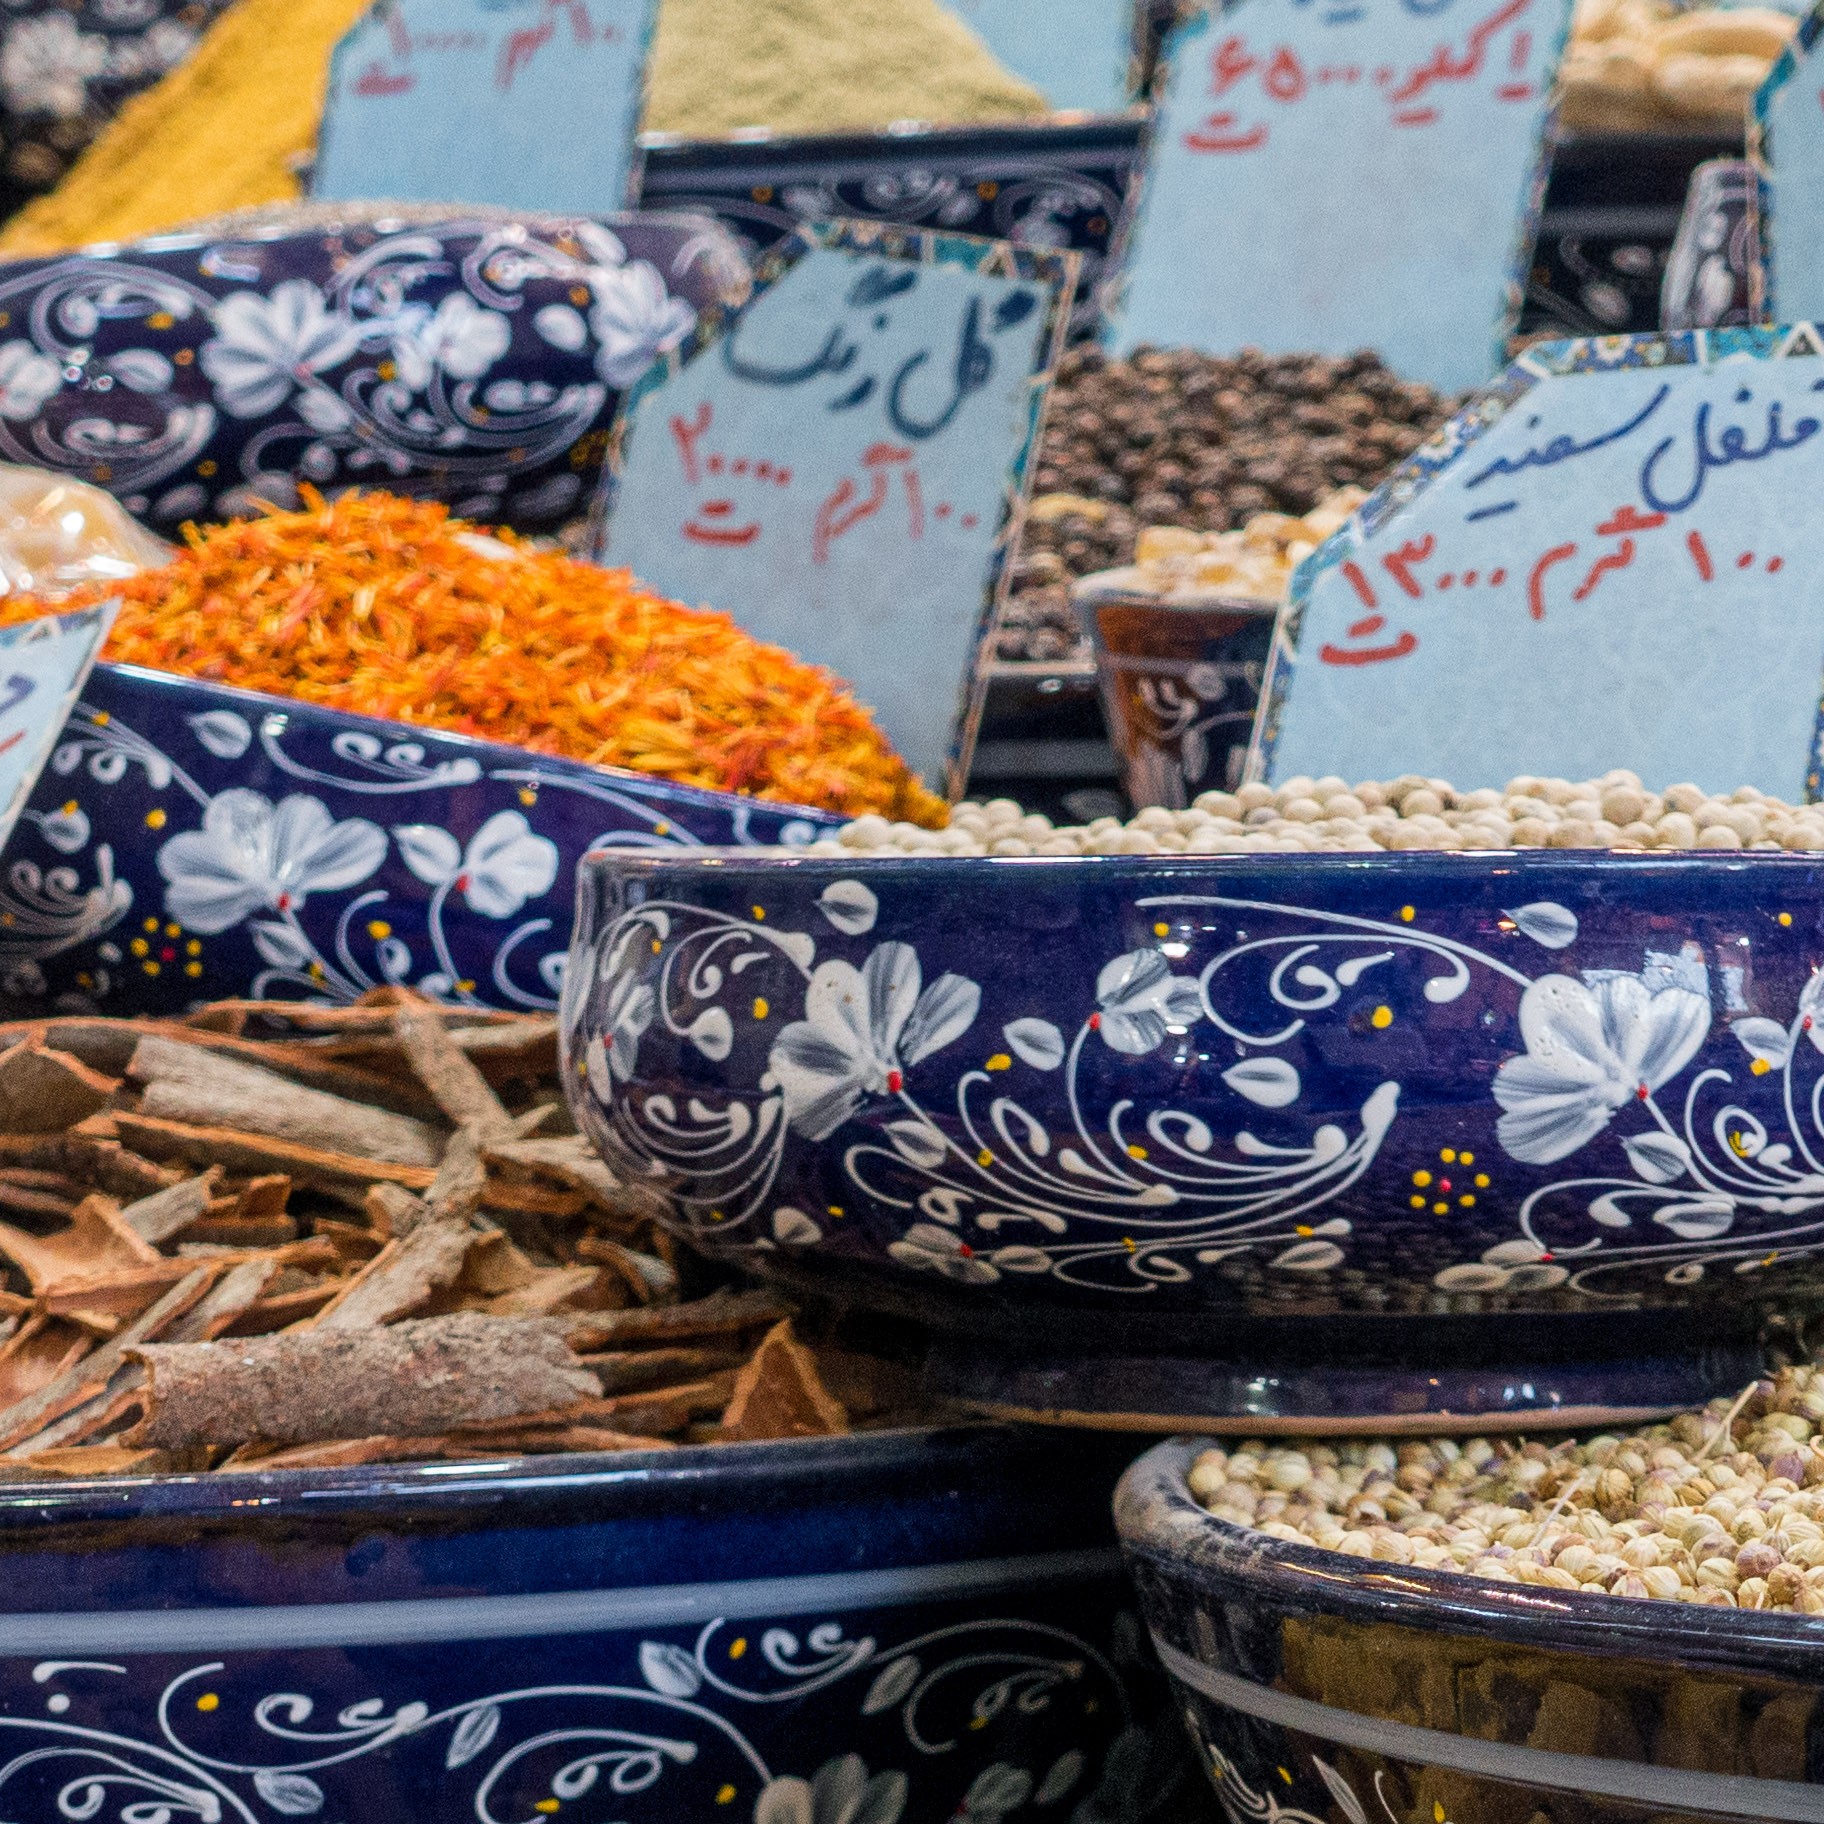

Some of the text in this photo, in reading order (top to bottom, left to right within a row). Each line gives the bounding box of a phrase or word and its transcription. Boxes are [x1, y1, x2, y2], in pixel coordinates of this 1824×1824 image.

[811, 441, 915, 566] گرم
[1464, 382, 1670, 523] سفید
[1341, 504, 1785, 621] ۱۰۰ گرم ۱۳۰۰۰
